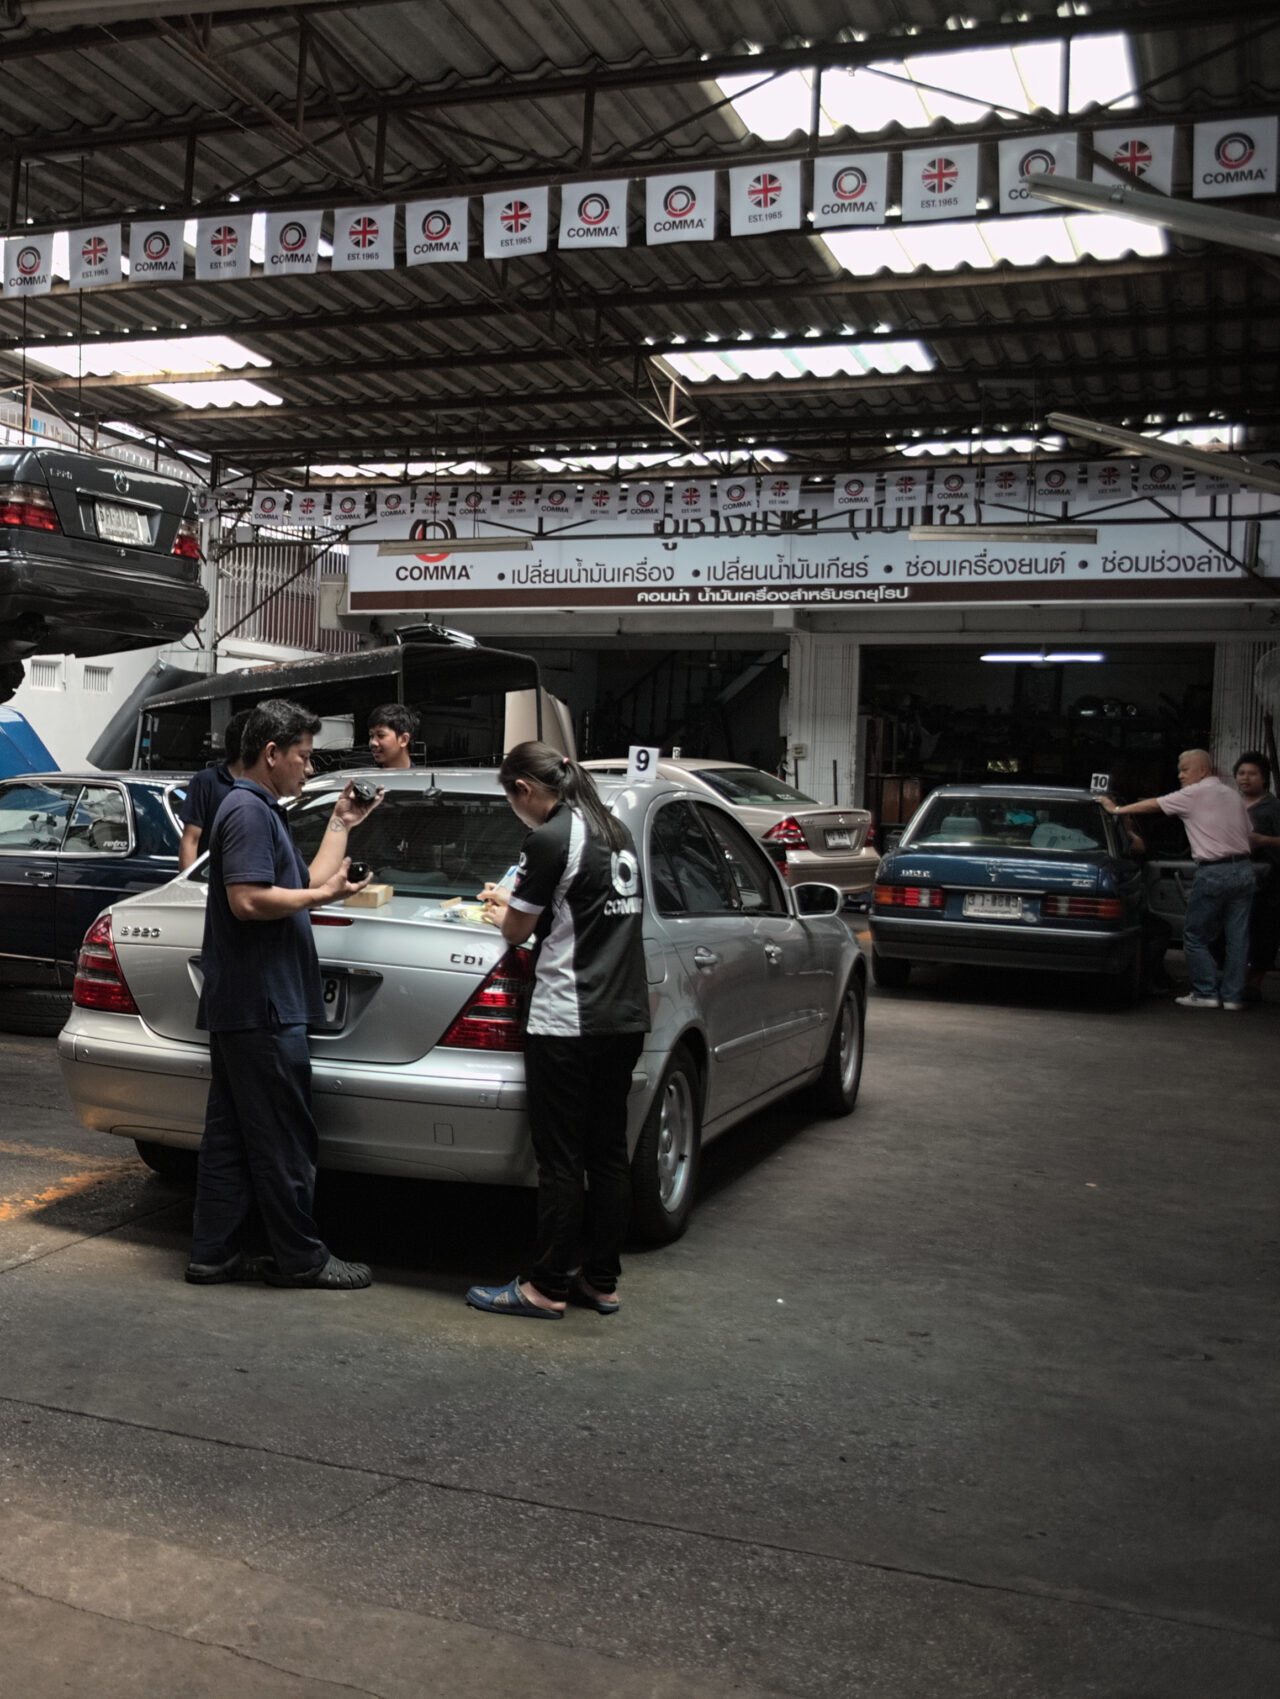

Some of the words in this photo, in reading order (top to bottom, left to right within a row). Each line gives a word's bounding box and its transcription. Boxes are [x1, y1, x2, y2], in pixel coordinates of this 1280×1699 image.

[1202, 170, 1265, 186] COMMA
[821, 201, 875, 215] COMMA
[653, 219, 704, 233] COMMA
[567, 227, 617, 239] COMMA
[413, 242, 459, 255] COMMA
[271, 254, 313, 265] COMMA
[134, 262, 176, 273] COMMA
[9, 276, 47, 288] COMMA
[722, 501, 751, 511] COMMA
[395, 564, 471, 582] COMMA
[635, 749, 650, 772] 9
[1093, 775, 1108, 788] 10
[450, 953, 483, 966] CDI
